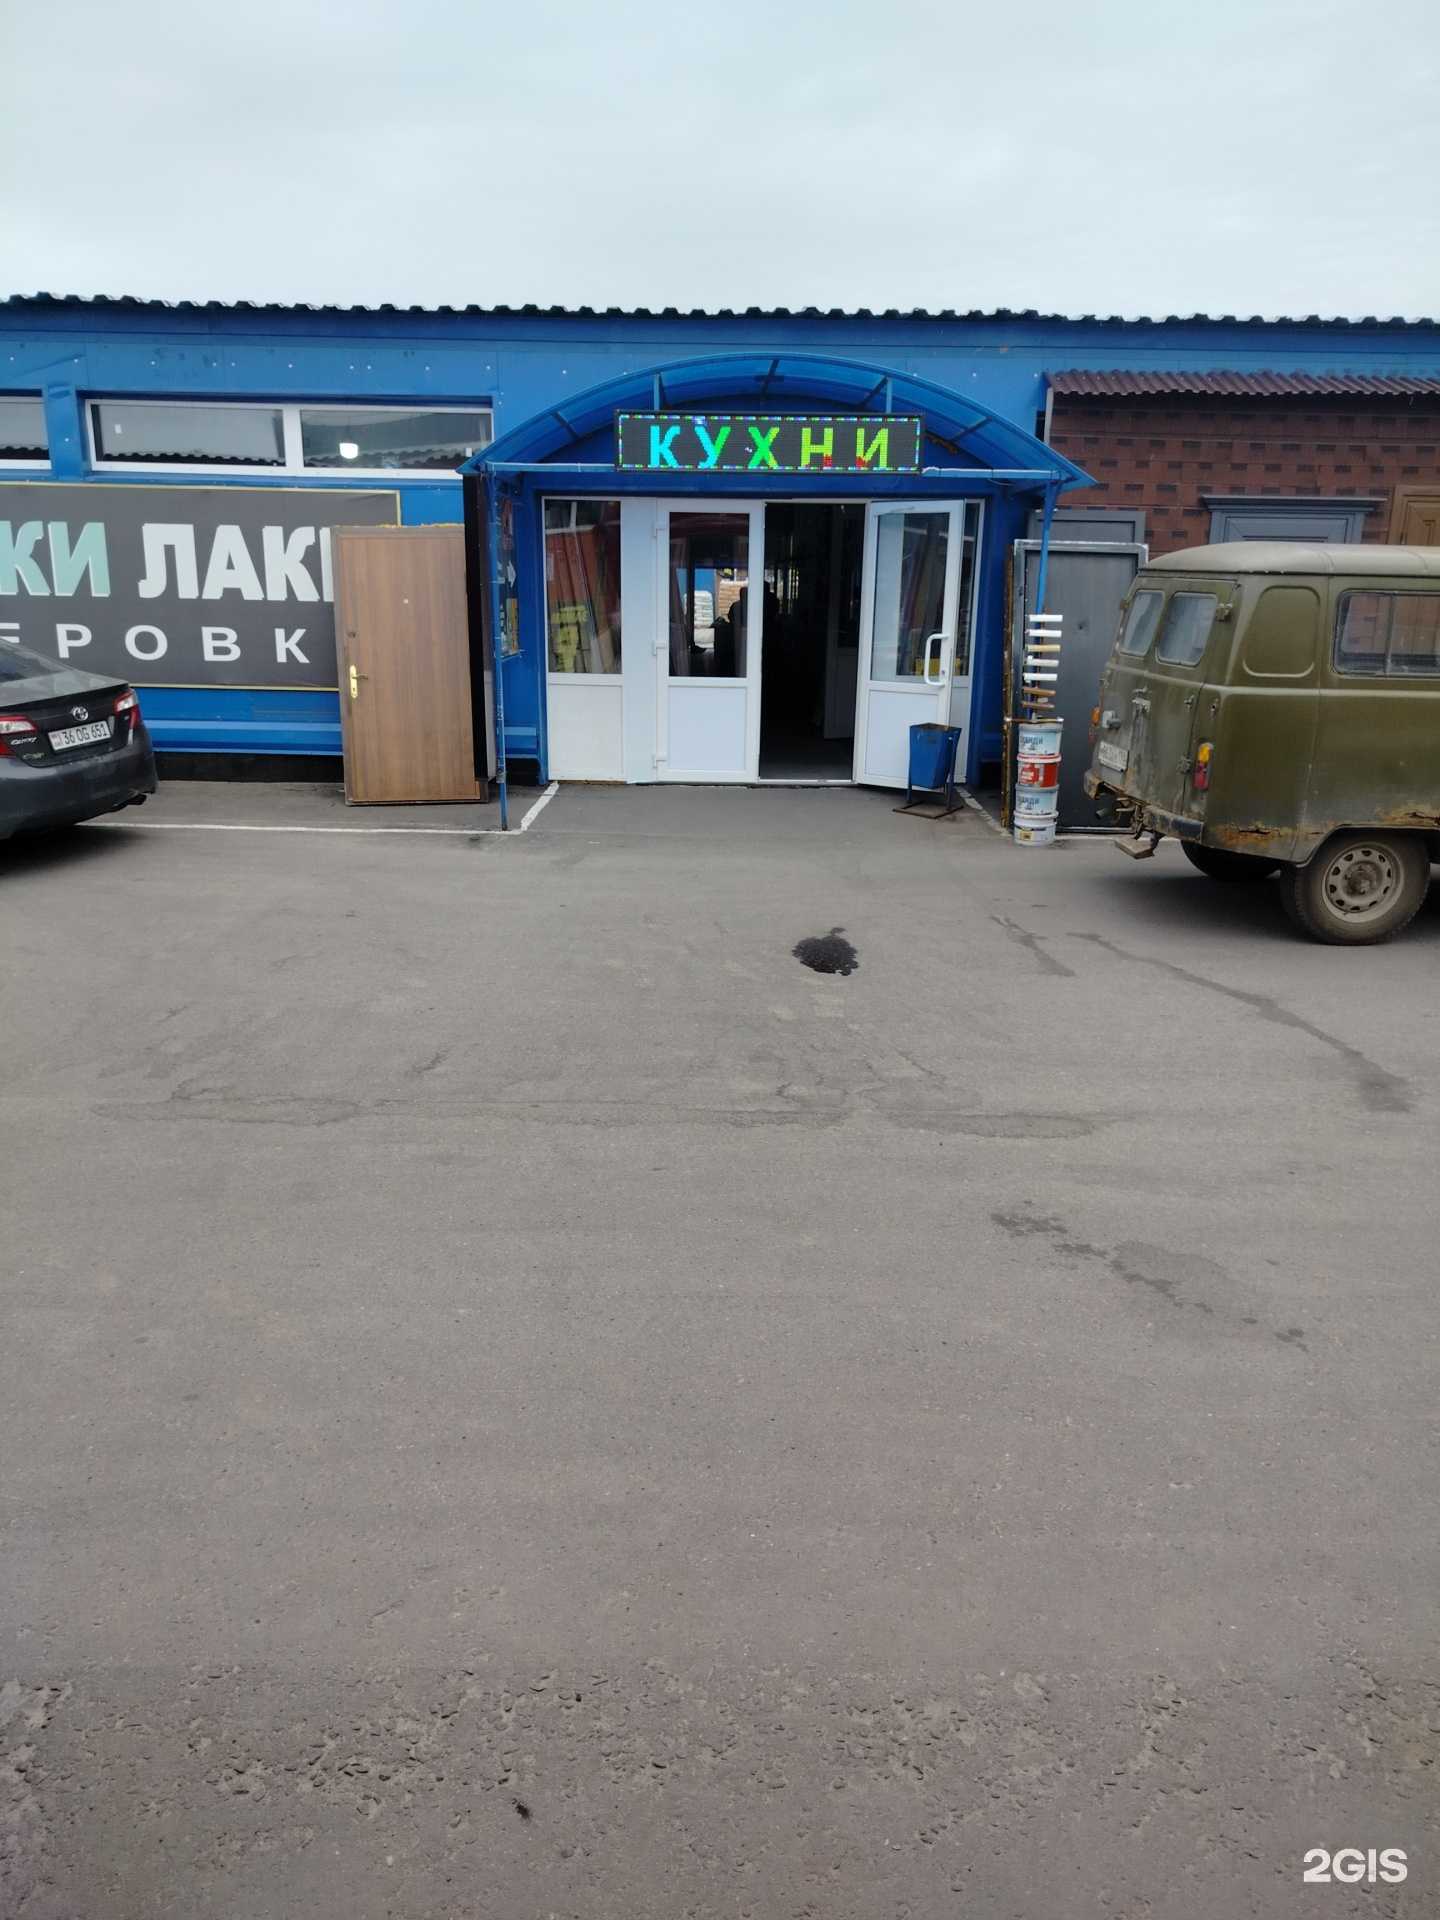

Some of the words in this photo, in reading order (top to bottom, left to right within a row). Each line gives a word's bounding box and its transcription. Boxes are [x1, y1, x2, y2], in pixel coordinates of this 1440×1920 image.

[650, 425, 889, 468] КУХНИ
[137, 523, 335, 602] ЛАК
[62, 730, 76, 745] 36
[91, 723, 108, 739] 651
